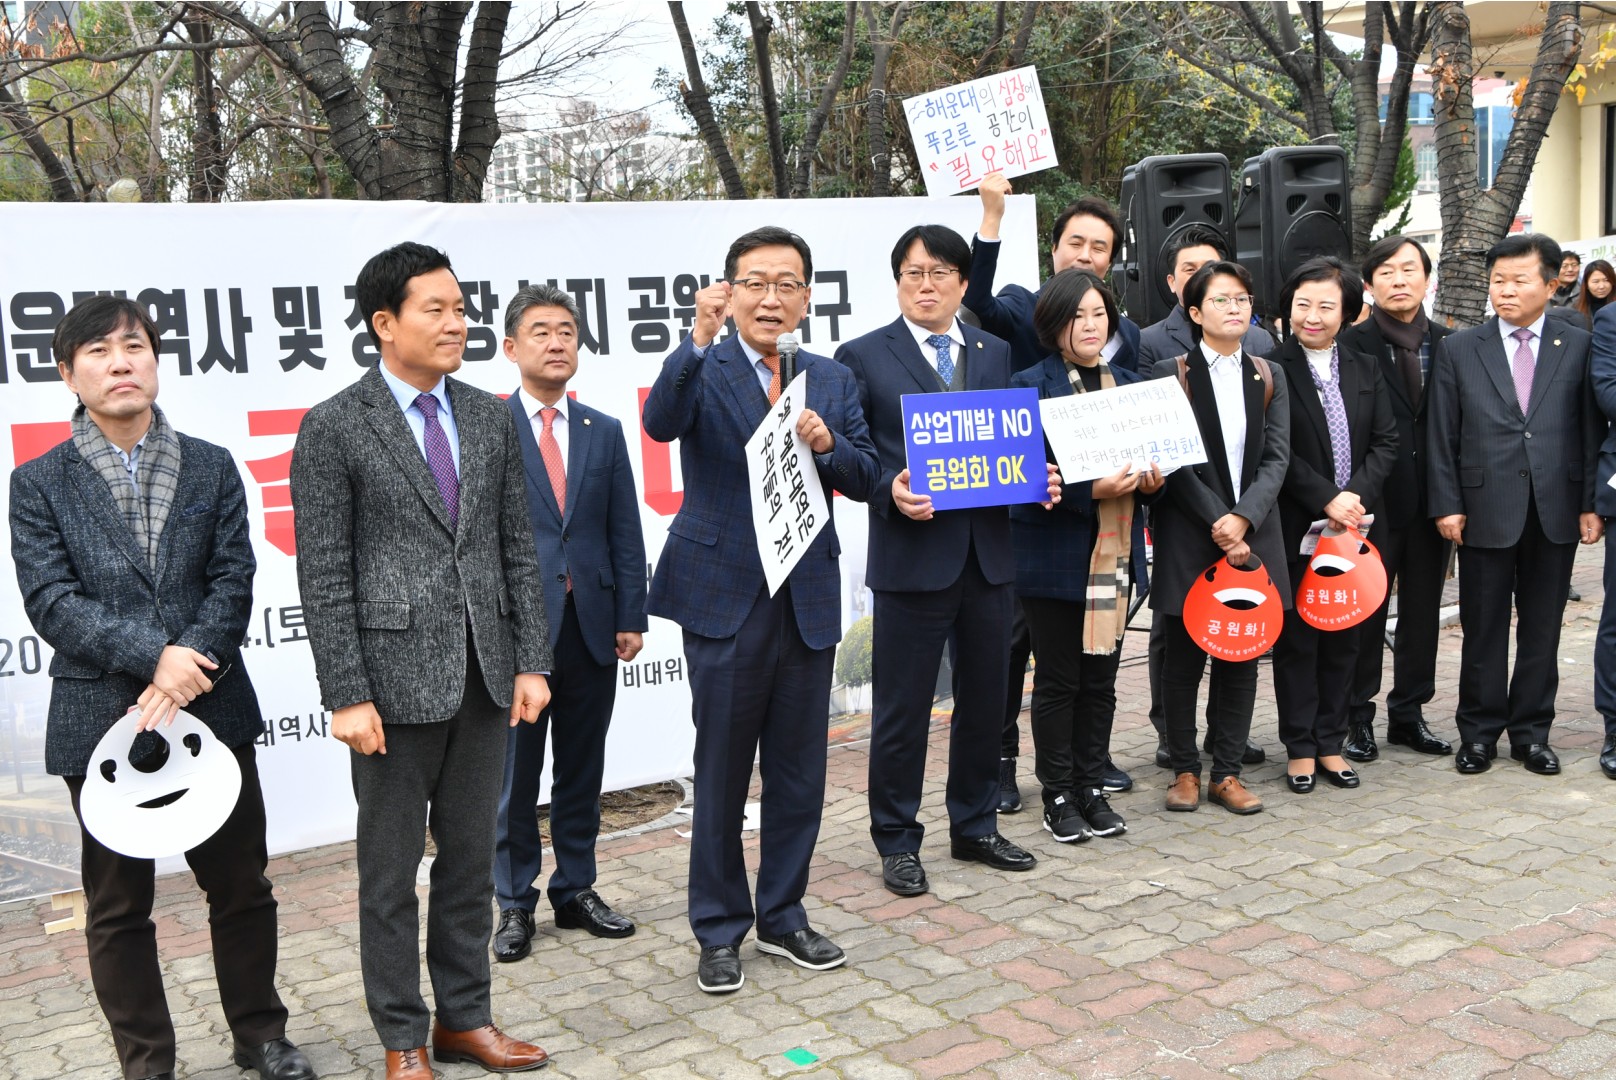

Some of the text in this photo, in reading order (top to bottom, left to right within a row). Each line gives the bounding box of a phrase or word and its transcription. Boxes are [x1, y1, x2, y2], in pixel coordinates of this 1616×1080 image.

[924, 73, 1040, 120] 해운대의 심장에
[924, 104, 1035, 154] 푸르른 공간이
[273, 286, 327, 373] 및
[910, 407, 1033, 446] 상업개발 NO
[760, 431, 783, 524] 우리들의
[926, 454, 1028, 492] 공원화 OK
[622, 657, 683, 688] 비대위
